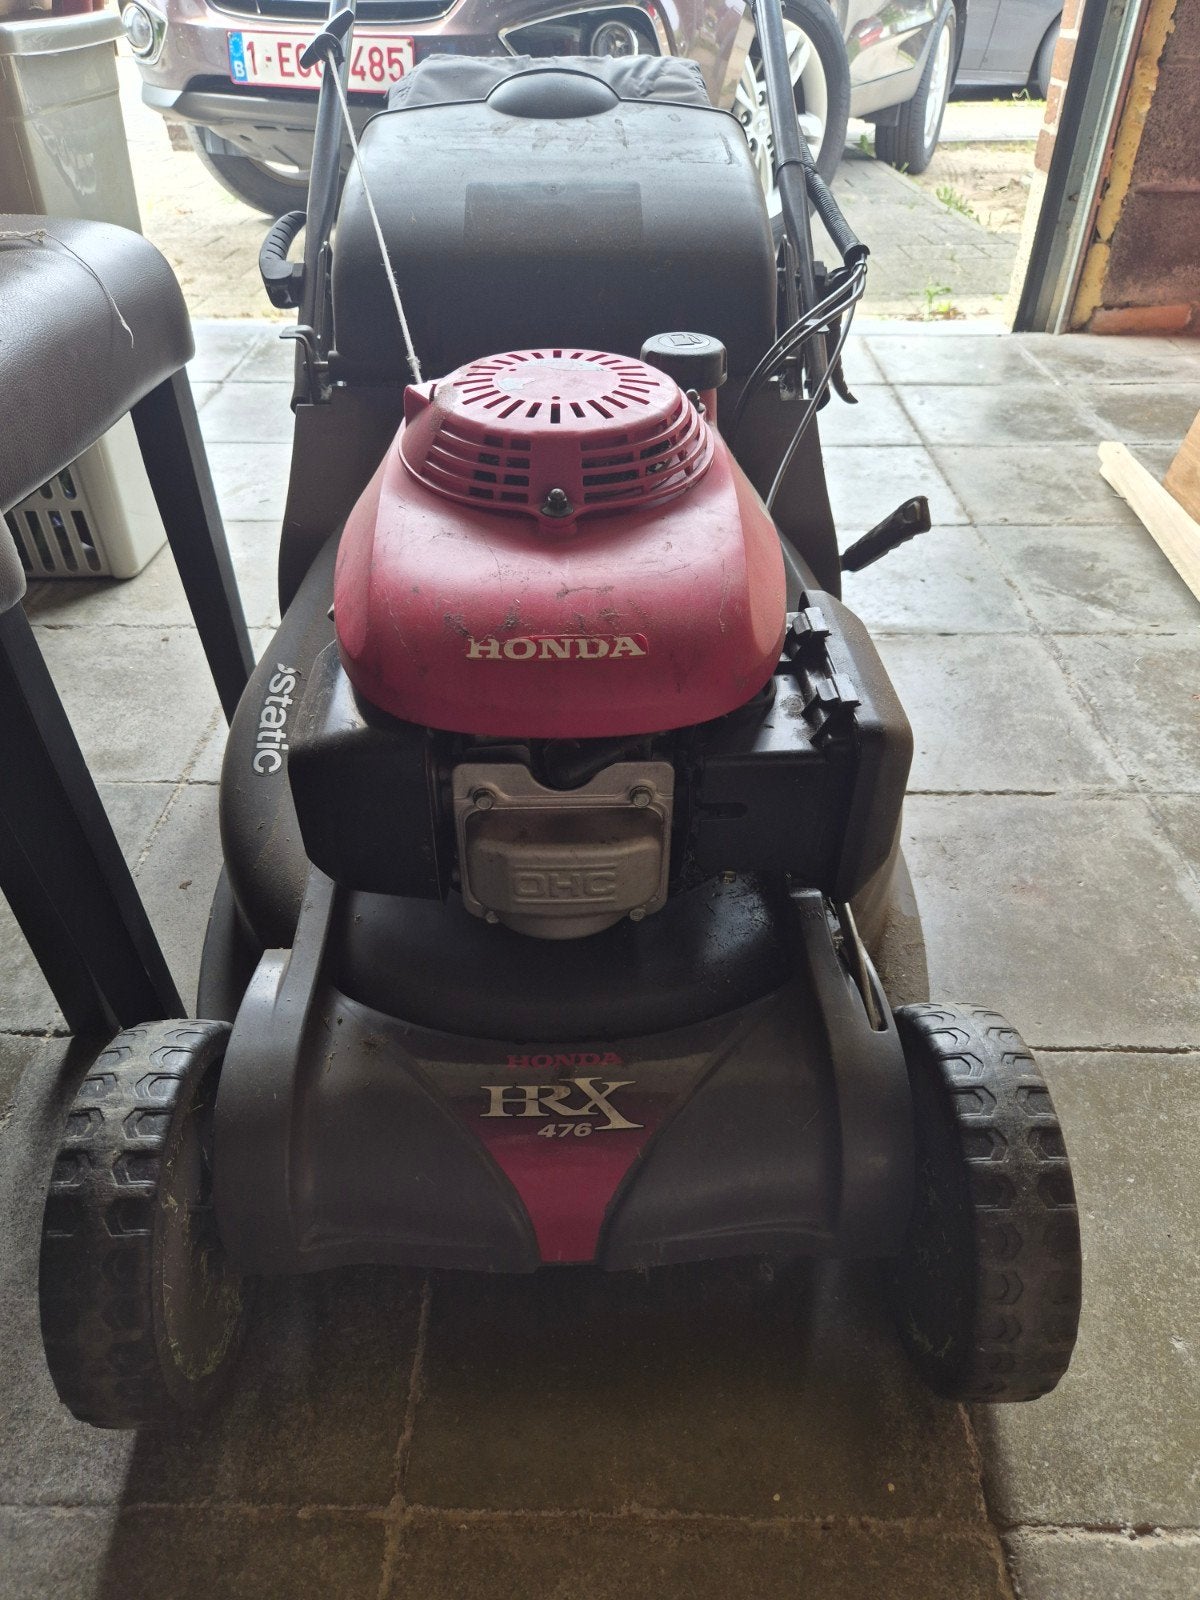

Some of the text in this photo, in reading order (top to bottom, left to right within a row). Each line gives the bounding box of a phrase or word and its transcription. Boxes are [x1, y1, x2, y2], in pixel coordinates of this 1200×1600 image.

[233, 60, 246, 77] B
[465, 636, 647, 660] HONDA
[514, 871, 616, 898] OHC
[506, 1052, 623, 1070] HONDA
[479, 1076, 645, 1130] HRX
[537, 1122, 593, 1138] 476
